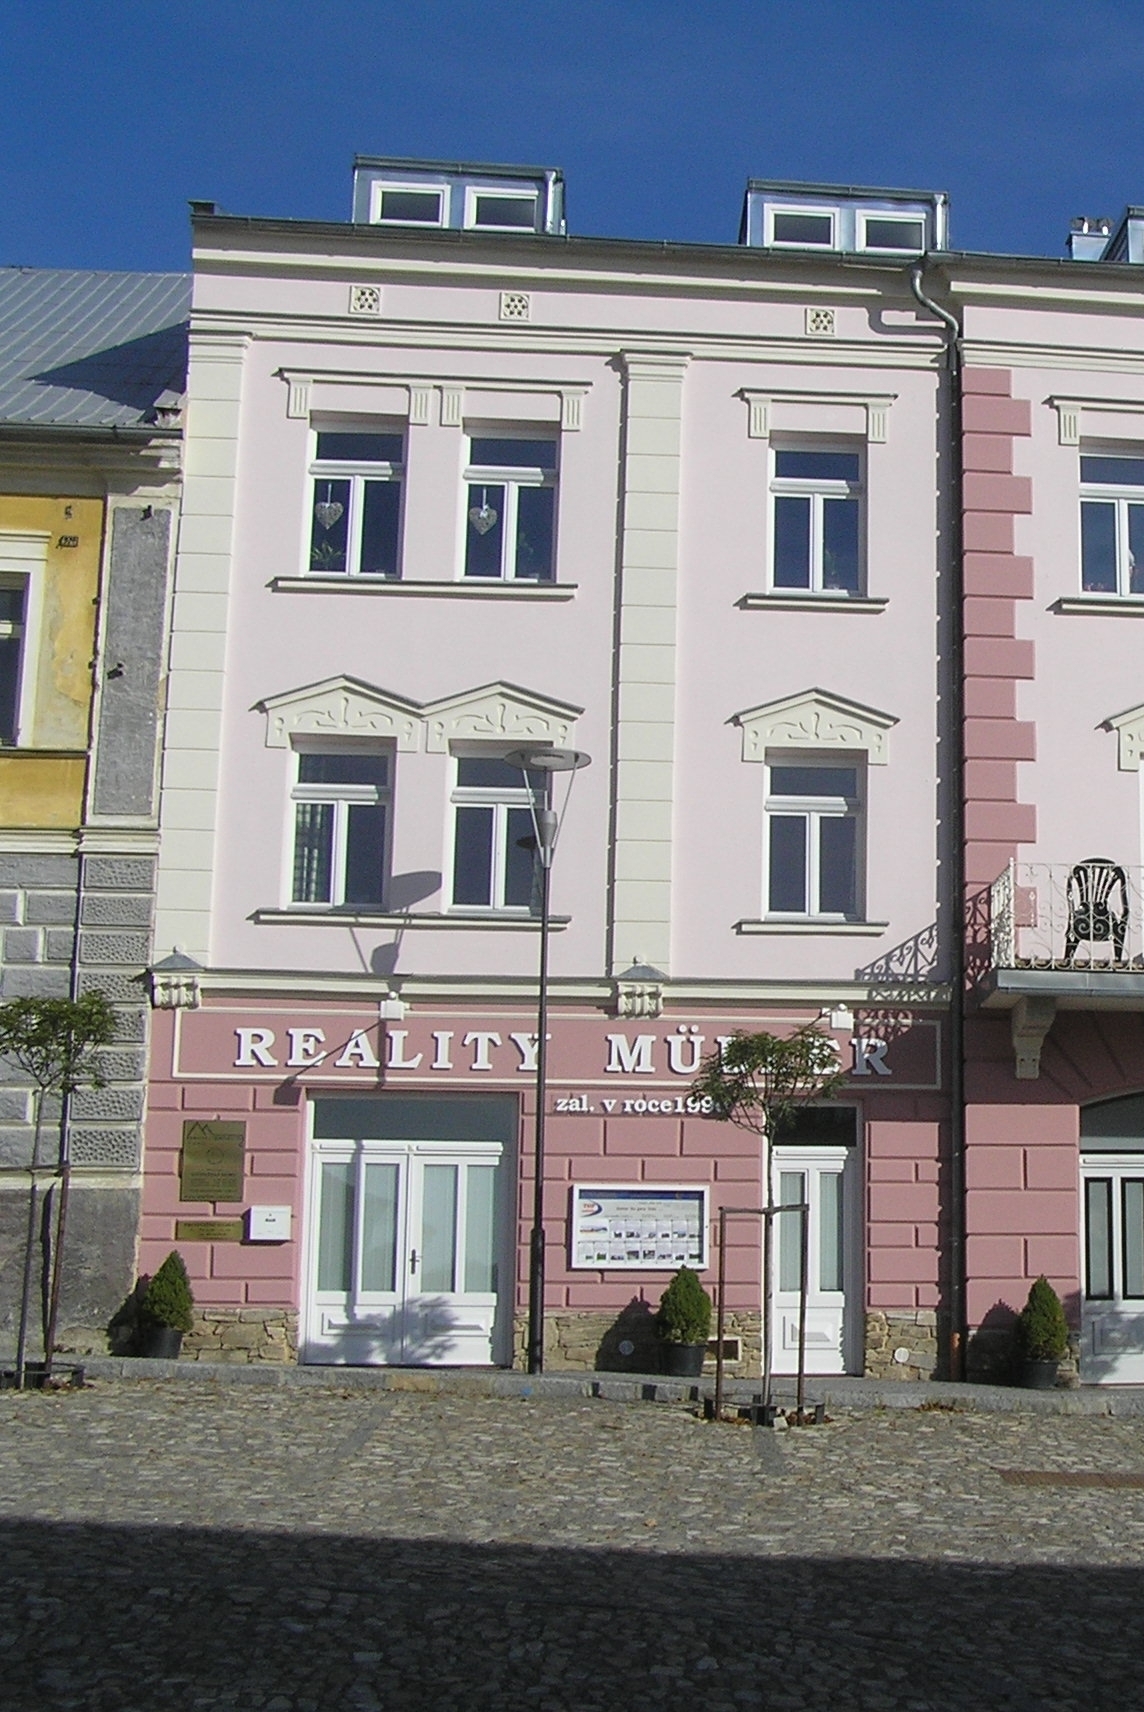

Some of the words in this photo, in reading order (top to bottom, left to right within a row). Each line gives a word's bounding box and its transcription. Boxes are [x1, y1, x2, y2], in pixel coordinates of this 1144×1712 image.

[233, 1027, 552, 1071] REALITY
[605, 1023, 893, 1076] MÜLER
[556, 1094, 595, 1112] zal.
[602, 1099, 618, 1112] v
